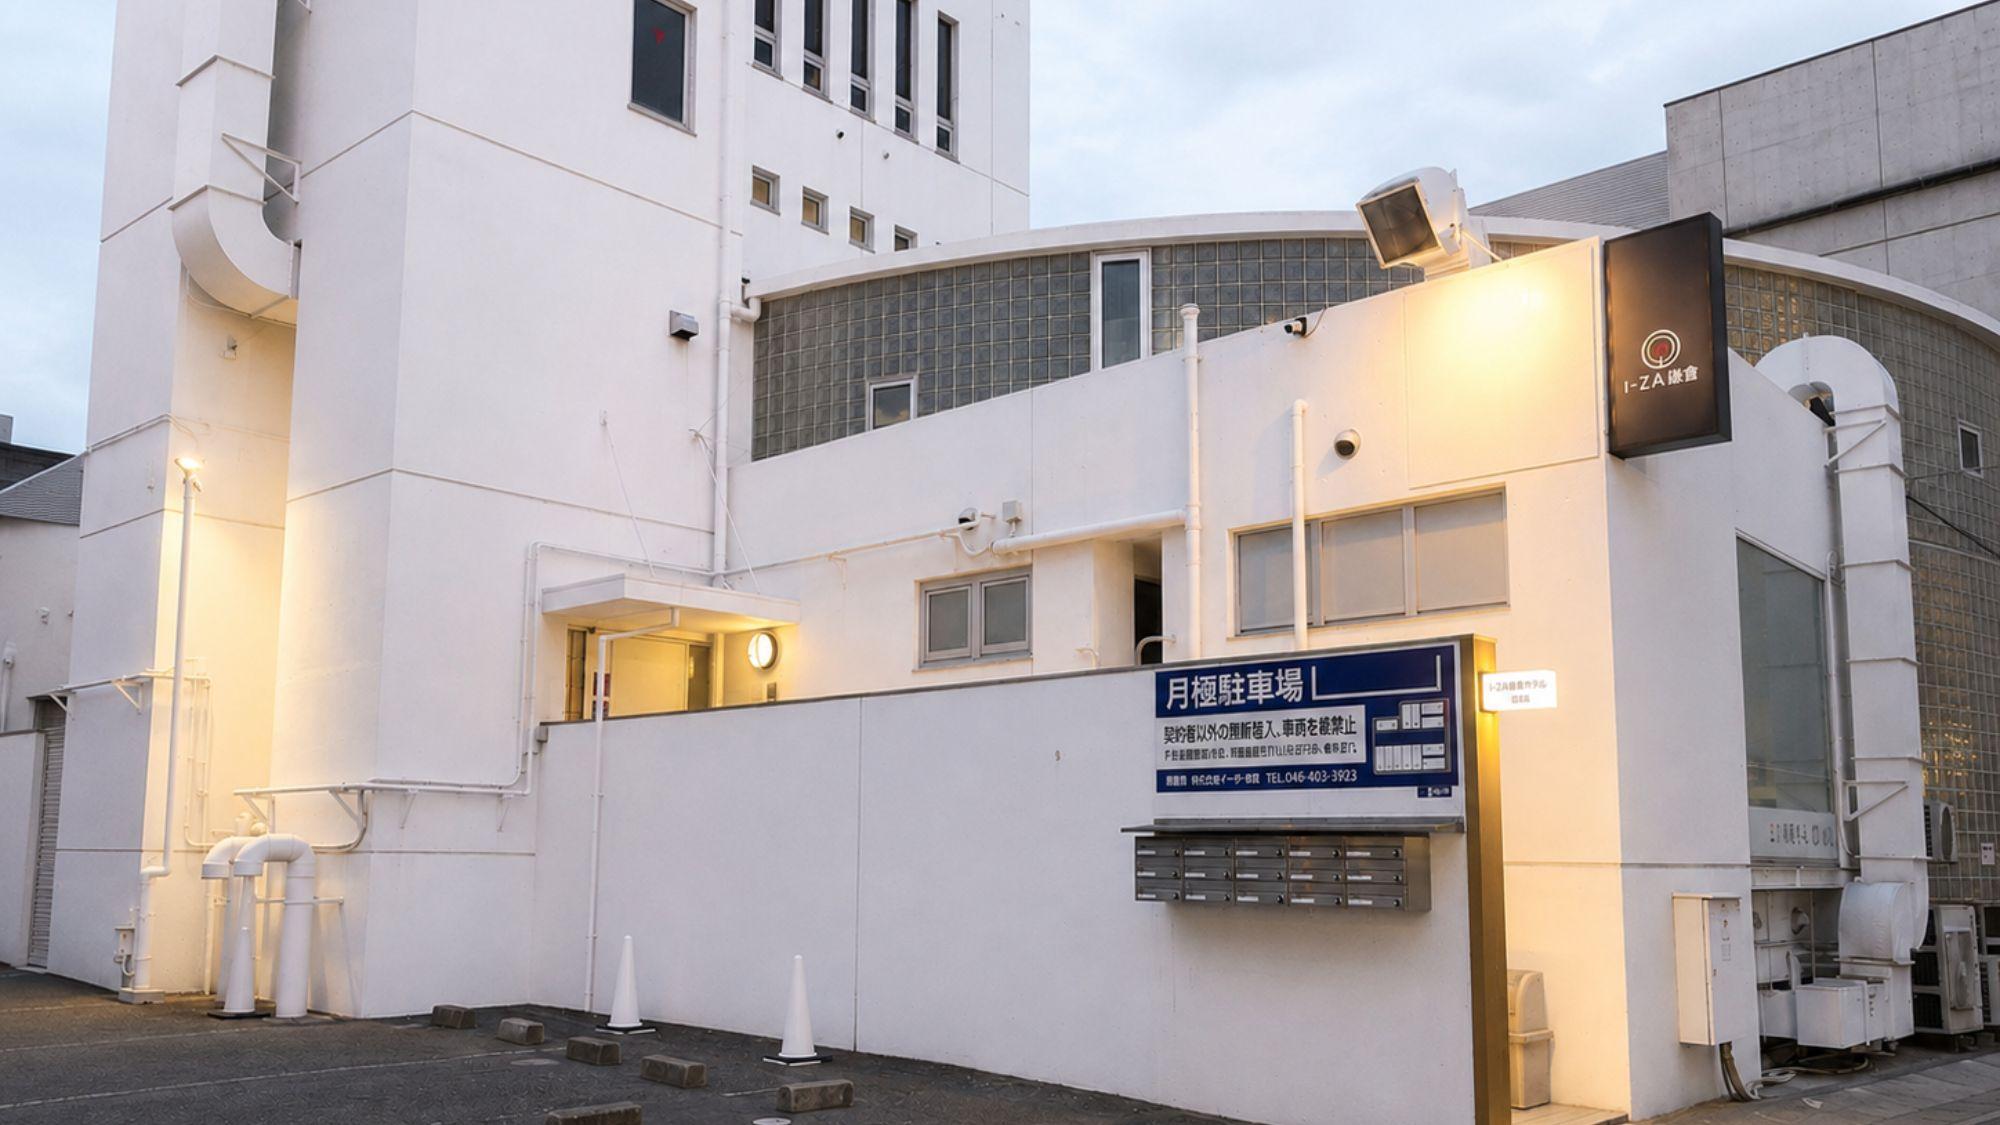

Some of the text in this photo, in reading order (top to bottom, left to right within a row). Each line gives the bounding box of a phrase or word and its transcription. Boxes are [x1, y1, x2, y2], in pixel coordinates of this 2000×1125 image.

[1166, 668, 1304, 710] 月極駐車場
